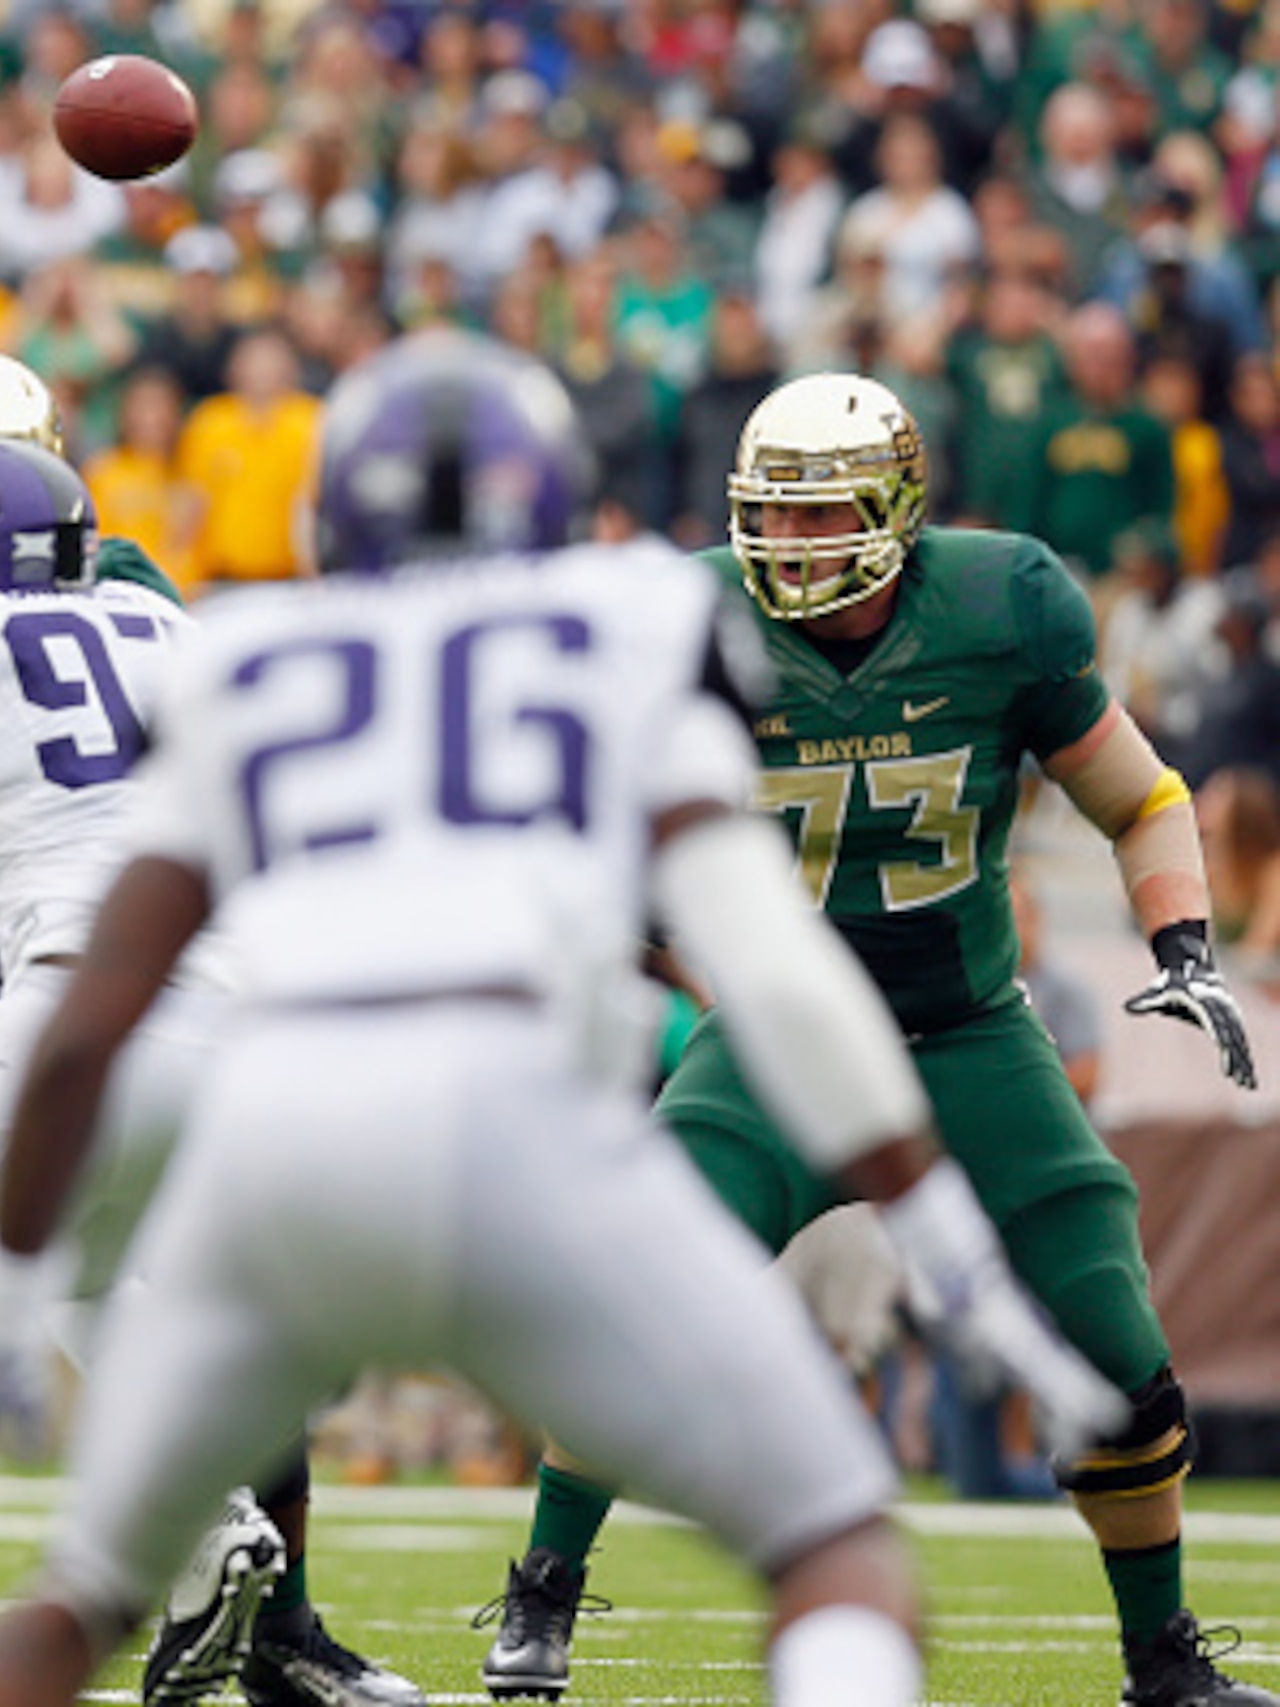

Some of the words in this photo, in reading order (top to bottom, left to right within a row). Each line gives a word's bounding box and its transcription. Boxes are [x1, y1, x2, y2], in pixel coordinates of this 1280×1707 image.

[232, 613, 592, 874] 26
[796, 731, 912, 766] BAYLOR
[754, 745, 981, 912] 73
